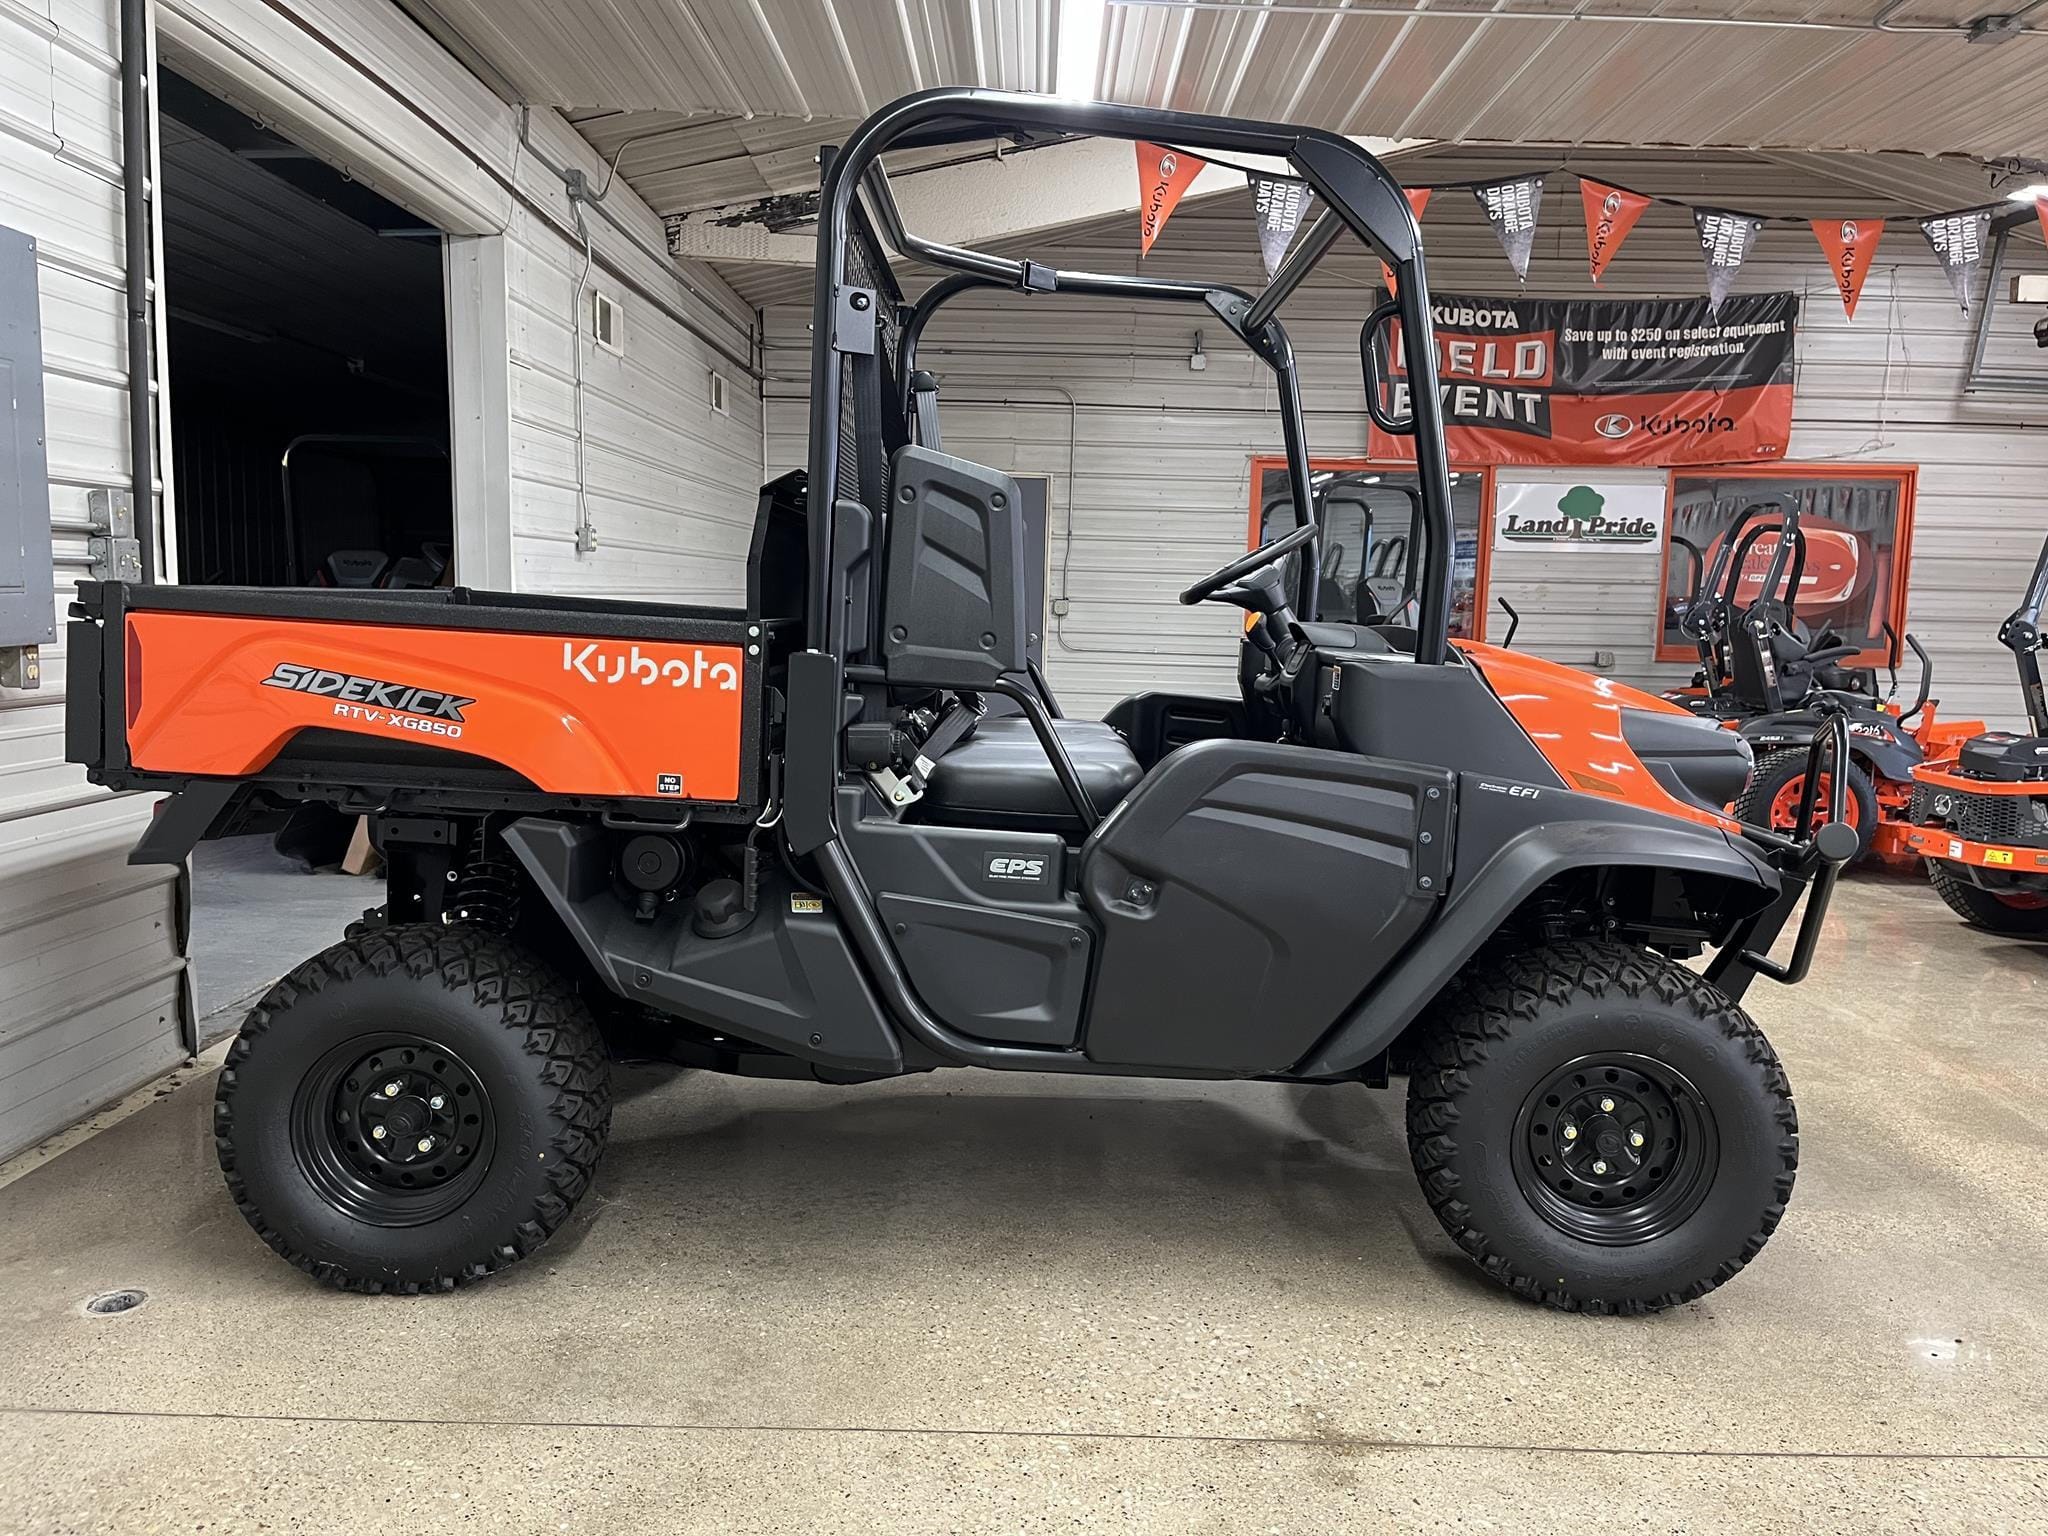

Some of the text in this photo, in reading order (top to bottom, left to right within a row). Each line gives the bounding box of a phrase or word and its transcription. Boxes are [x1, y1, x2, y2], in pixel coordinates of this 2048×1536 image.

[1143, 181, 1169, 237] Kubota
[1256, 180, 1273, 214] DAYS
[1266, 182, 1287, 232] ORANGE
[1281, 184, 1301, 232] KUBOTA
[1486, 186, 1503, 221] DAYS
[1501, 184, 1519, 234] ORANGE
[1515, 182, 1534, 230] KUBOTA
[1702, 215, 1720, 249] DAYS
[1711, 218, 1734, 267] ORANGE
[1726, 219, 1748, 267] KUBOTA
[1932, 219, 1948, 253] DAYS
[1947, 217, 1964, 266] ORANGE
[1962, 214, 1980, 263] KUBOTA
[1841, 247, 1855, 304] Kubota
[1430, 306, 1519, 329] KUBOTA
[1564, 320, 1785, 344] Save up to $250 on select equipment
[1602, 342, 1745, 360] with event registration.
[1640, 412, 1734, 435] Kubota
[1506, 514, 1655, 535] Land Pride
[563, 642, 737, 691] Kubota
[261, 663, 476, 722] SIDEKICK
[333, 703, 462, 738] RTV-XG850
[659, 783, 680, 791] STEP
[664, 776, 676, 784] NO
[1508, 786, 1540, 799] EFI
[989, 858, 1044, 875] EPS
